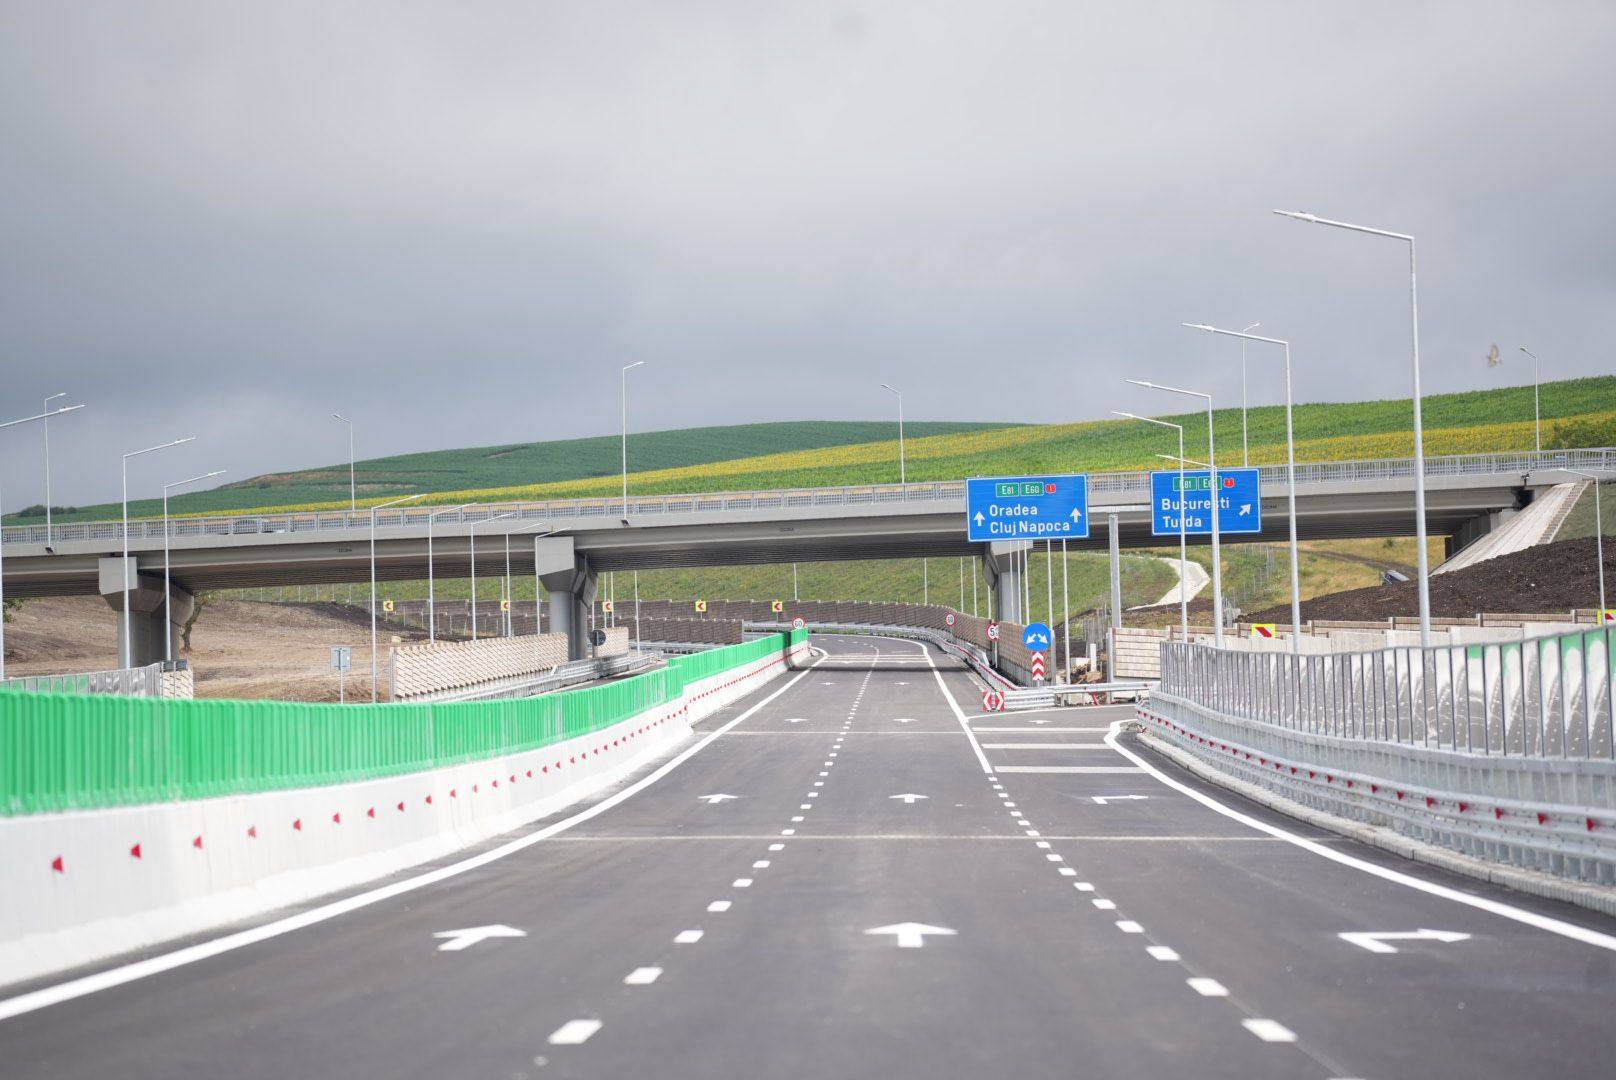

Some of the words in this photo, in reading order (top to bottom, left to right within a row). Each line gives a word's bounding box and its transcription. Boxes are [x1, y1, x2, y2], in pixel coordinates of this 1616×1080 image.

[1002, 485, 1014, 495] E81
[1025, 484, 1040, 494] E60
[989, 503, 1038, 517] Oradea
[990, 521, 1016, 535] Cluj
[1019, 520, 1070, 535] Napoca
[1162, 515, 1202, 528] Tuda
